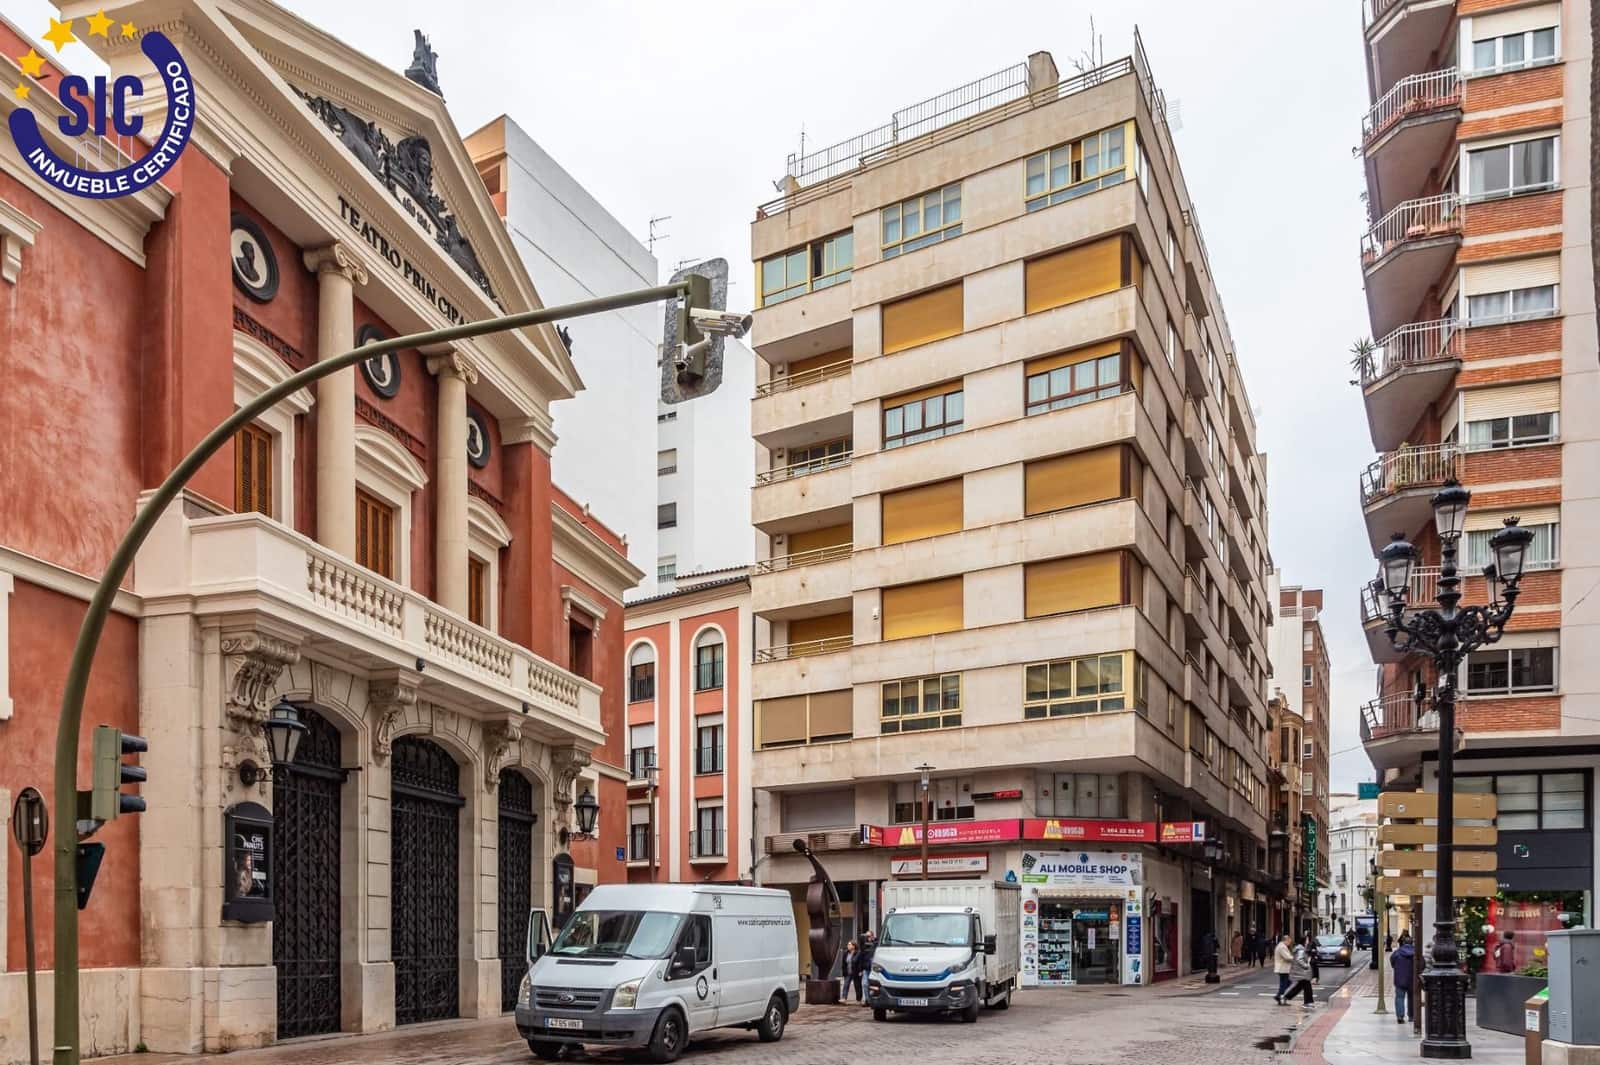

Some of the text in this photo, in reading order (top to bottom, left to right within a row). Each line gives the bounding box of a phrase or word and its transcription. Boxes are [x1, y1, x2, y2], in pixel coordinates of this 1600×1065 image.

[337, 195, 402, 271] TEATRO
[1194, 823, 1203, 838] L
[1039, 864, 1128, 874] ALI MOBILE SHOP
